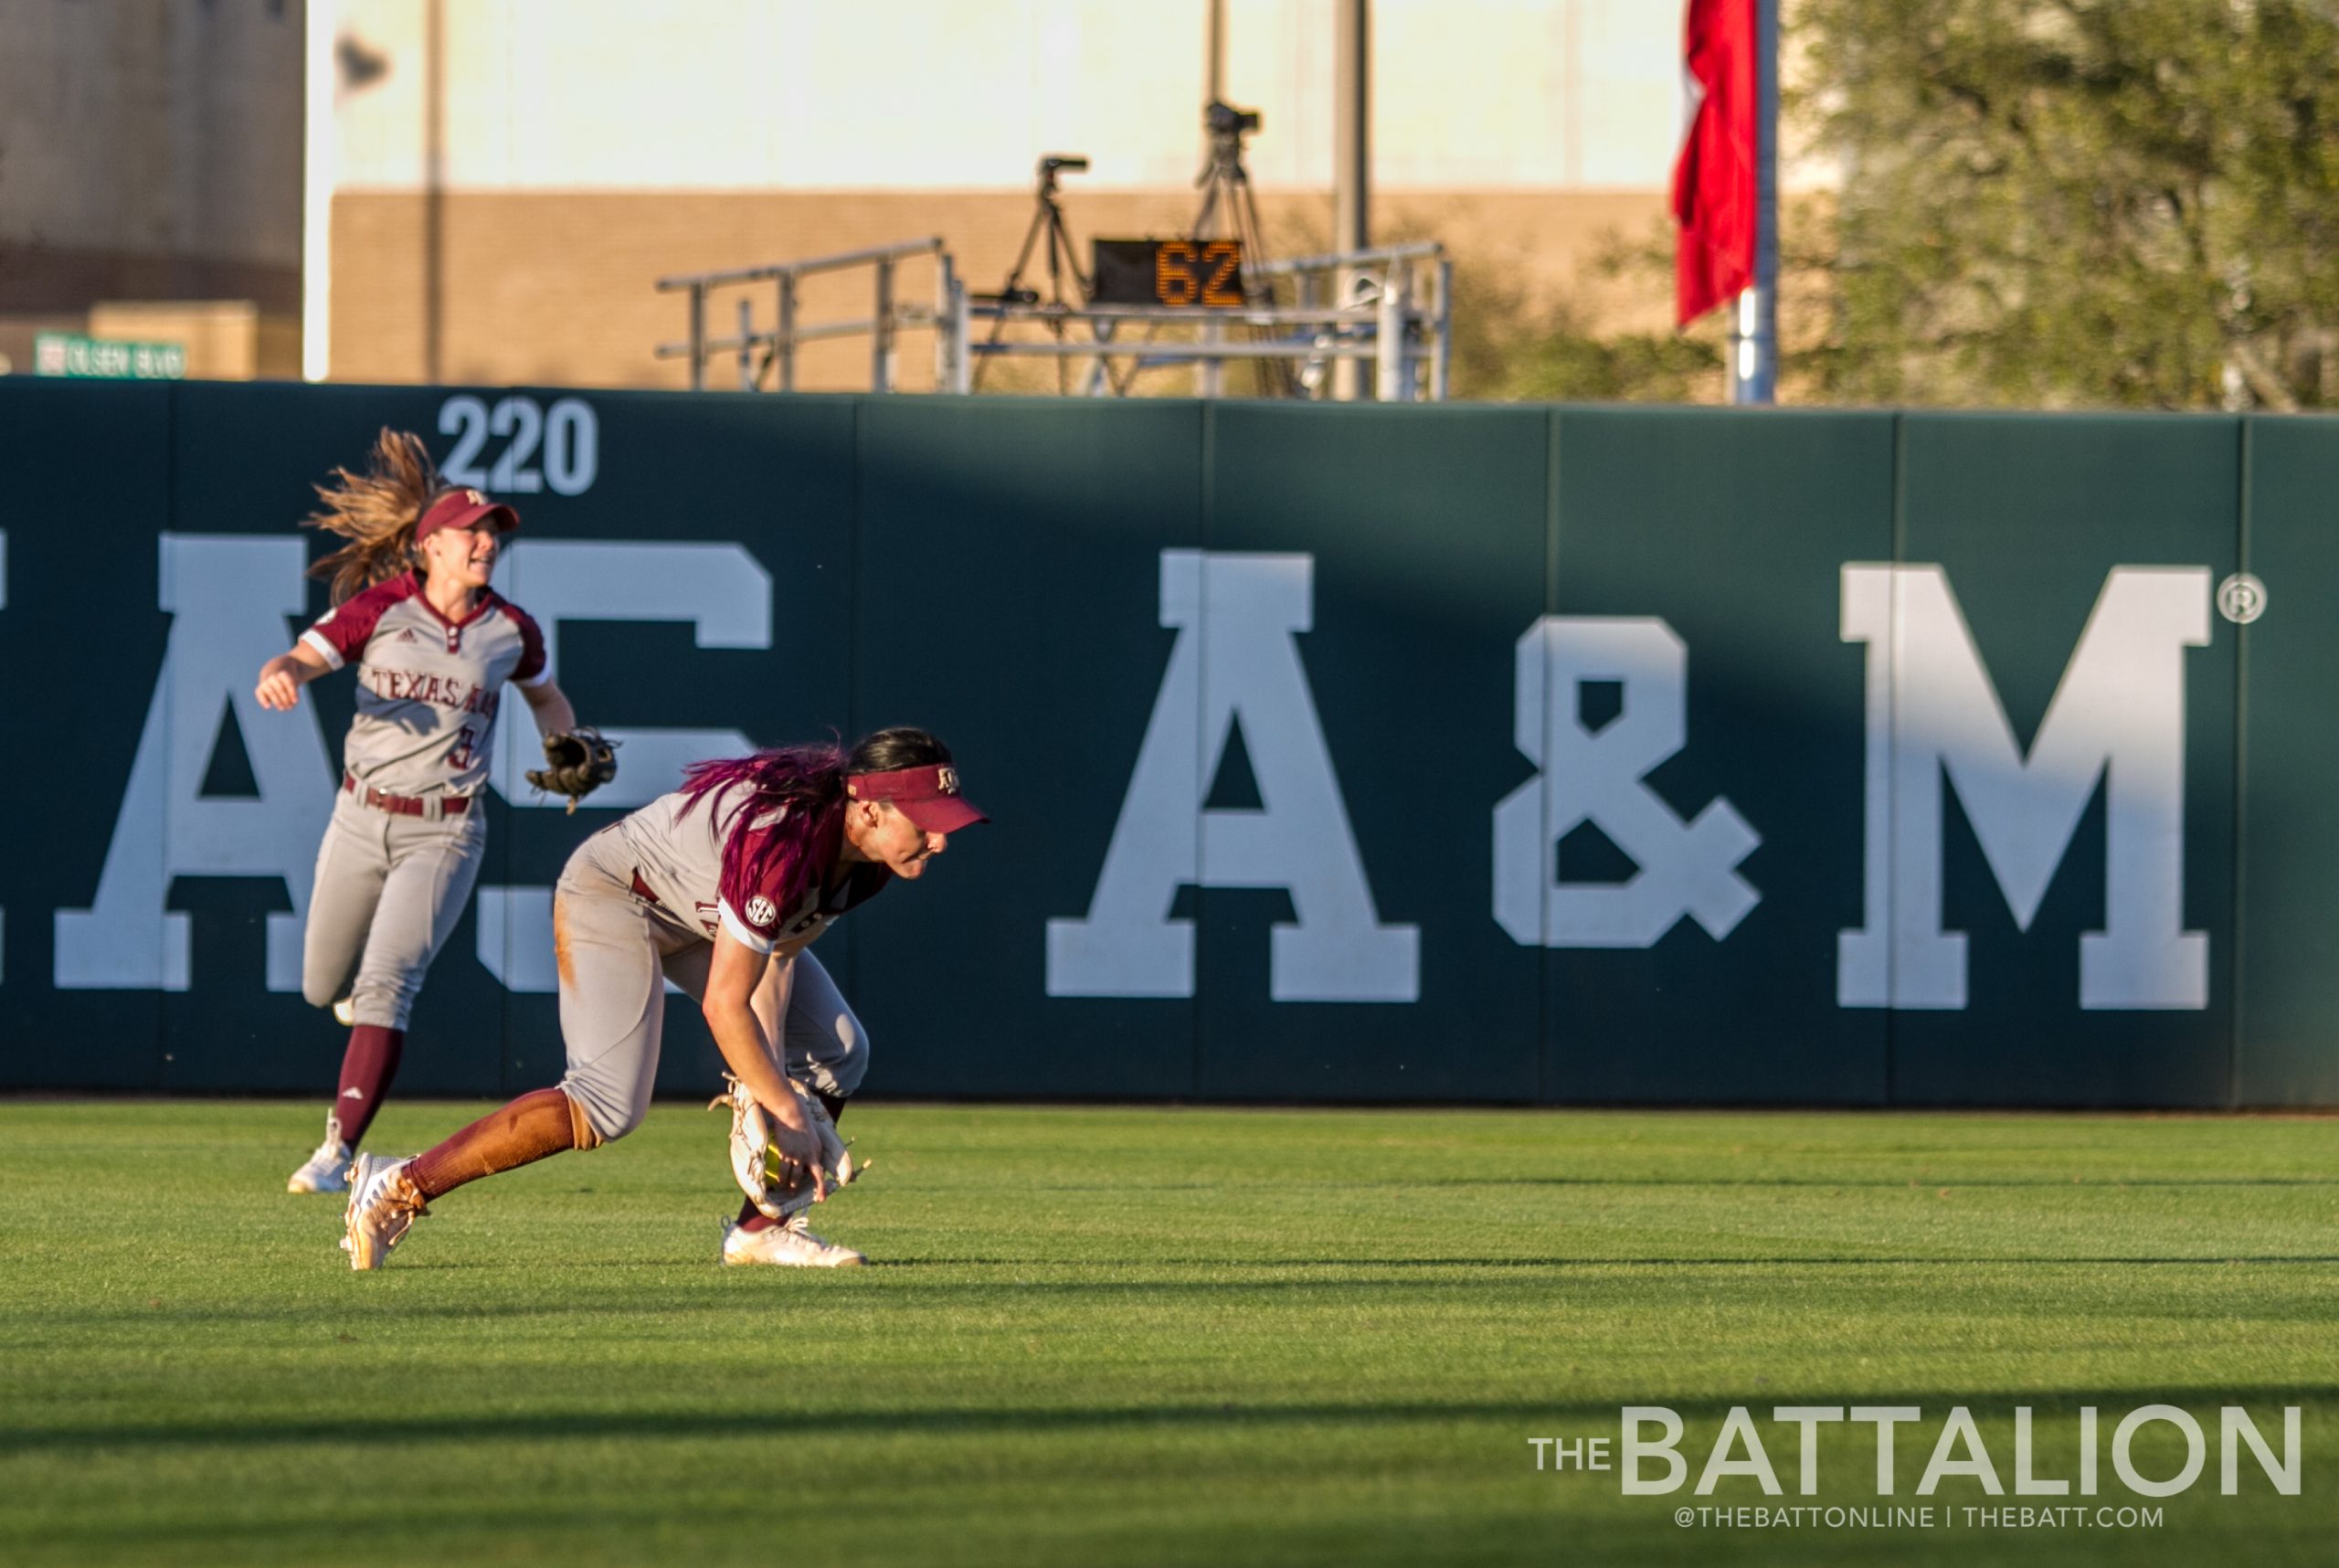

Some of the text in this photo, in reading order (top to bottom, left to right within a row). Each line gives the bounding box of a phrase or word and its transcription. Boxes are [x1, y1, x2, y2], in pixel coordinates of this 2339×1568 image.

[1156, 240, 1243, 308] 62
[438, 395, 599, 496] 220
[371, 669, 460, 708] TEXAS
[745, 895, 776, 926] SEC
